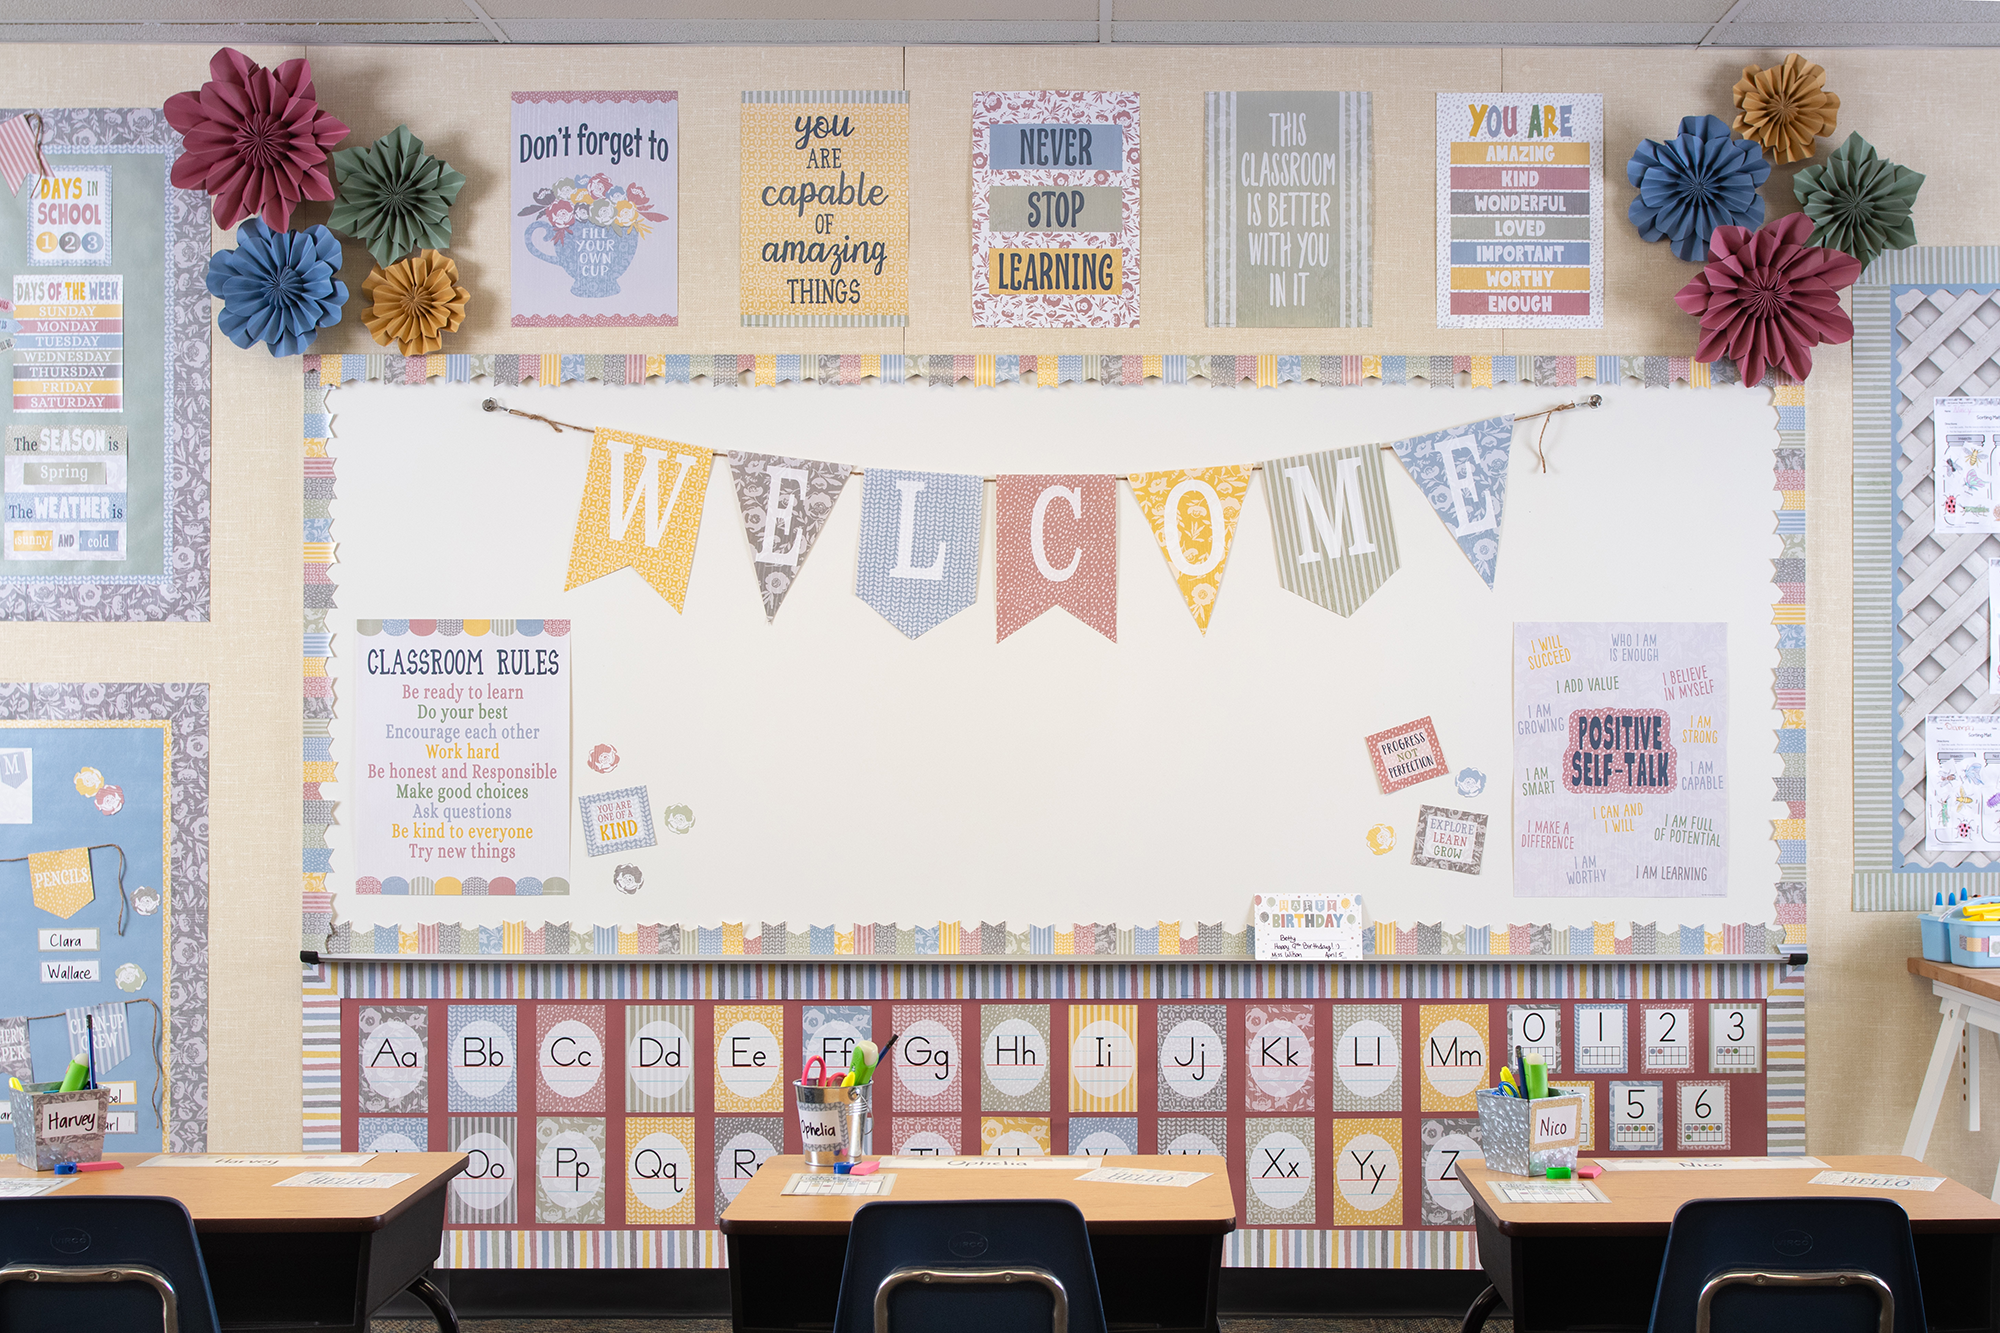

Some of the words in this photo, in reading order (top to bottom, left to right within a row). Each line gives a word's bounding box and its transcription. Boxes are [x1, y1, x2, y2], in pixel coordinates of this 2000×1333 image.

[1268, 111, 1307, 147] THIS
[1468, 103, 1518, 138] YOU
[1527, 104, 1573, 138] ARE
[795, 114, 855, 150] you
[520, 125, 571, 163] Don't
[577, 122, 643, 165] forget
[648, 129, 669, 162] to
[1019, 127, 1093, 167] NEVER
[1486, 145, 1555, 162] AMAZING
[806, 148, 842, 169] ARE
[1241, 151, 1336, 187] CLASSROOM
[41, 177, 82, 200] DAYS
[87, 181, 98, 196] IN
[1501, 170, 1539, 187] KIND
[761, 170, 889, 218] capable
[1474, 195, 1566, 212] WONDERFUL
[37, 202, 101, 225] SCHOOL
[1027, 190, 1085, 228] STOP
[1247, 192, 1262, 227] IS
[1267, 191, 1331, 228] BETTER
[582, 227, 608, 240] FILL
[815, 213, 834, 235] OF
[1495, 220, 1545, 237] LOVED
[575, 239, 615, 252] YOUR
[761, 234, 888, 276] amazing
[1248, 231, 1292, 268] WITH
[1297, 231, 1329, 269] YOU
[1476, 245, 1565, 262] IMPORTANT
[579, 252, 612, 264] OWN
[581, 265, 609, 277] CUP
[998, 252, 1113, 291] LEARNING
[1486, 270, 1554, 287] WORTHY
[16, 282, 45, 301] DAYS
[48, 282, 62, 301] OF
[64, 282, 86, 301] THE
[89, 281, 118, 300] WEEK
[786, 278, 861, 305] THINGS
[1269, 271, 1286, 307] IN
[1293, 272, 1310, 307] IT
[38, 305, 97, 317] SUNDAY
[1488, 295, 1552, 313] ENOUGH
[36, 321, 99, 332] MONDAY
[35, 336, 101, 347] TUESDAY
[23, 351, 113, 362] WEDNESDAY
[29, 366, 107, 378] THURSDAY
[42, 381, 94, 393] FRIDAY
[30, 396, 106, 408] SATURDAY
[14, 436, 38, 452] The
[40, 428, 106, 452] SEASON
[40, 464, 88, 482] Spring
[9, 503, 33, 519] The
[34, 496, 111, 519] WEATHER
[606, 433, 1501, 583] WELCOME
[17, 535, 49, 548] sunny
[58, 534, 75, 548] AND
[88, 534, 109, 548] cold
[367, 648, 484, 676] CLASSROOM
[497, 649, 559, 676] RULES
[1527, 648, 1571, 671] SUCCEED
[1622, 648, 1659, 662] ENOUGH
[1587, 675, 1619, 692] VALUE
[1670, 665, 1708, 685] BELIEVE
[402, 684, 419, 700] Be
[424, 683, 464, 703] ready
[468, 685, 483, 700] to
[487, 683, 524, 700] learn
[1679, 679, 1715, 699] MYSELF
[417, 704, 436, 719] Do
[441, 707, 474, 723] your
[478, 702, 508, 719] best
[386, 723, 460, 743] Encourage
[465, 722, 497, 739] each
[501, 722, 540, 740] other
[1517, 717, 1565, 735] GROWING
[1578, 714, 1662, 751] POSITIVE
[1682, 729, 1718, 744] STRONG
[425, 742, 462, 759] Work
[467, 743, 500, 760] hard
[1381, 731, 1426, 756] PROGRESS
[1396, 748, 1419, 763] NOT
[368, 763, 385, 779] Be
[389, 762, 436, 779] honest
[442, 763, 467, 779] and
[472, 763, 557, 783] Responsible
[1388, 754, 1435, 779] PERFECTION
[1571, 750, 1669, 787] SELF-TALK
[396, 782, 433, 799] Make
[438, 783, 471, 803] good
[476, 783, 529, 799] choices
[1522, 780, 1555, 797] SMART
[1681, 775, 1724, 791] CAPABLE
[412, 802, 439, 819] Ask
[443, 803, 512, 822] questions
[391, 823, 409, 838] Be
[413, 822, 445, 838] kind
[468, 828, 533, 843] everyone
[599, 819, 638, 842] KIND
[1430, 818, 1475, 836] EXPLORE
[1432, 832, 1468, 847] LEARN
[1521, 834, 1575, 850] DIFFERENCE
[1669, 829, 1721, 848] POTENTIAL
[409, 844, 431, 862] Try
[438, 846, 467, 859] new
[471, 842, 516, 862] things
[1433, 845, 1462, 859] GROW
[34, 867, 89, 889] PENCILS
[1566, 868, 1607, 885] WORTHY
[1661, 866, 1708, 881] LEARNING
[1280, 900, 1336, 909] HAPPY
[1272, 913, 1344, 928] BIRTHDAY
[50, 934, 82, 948] Clara
[47, 964, 92, 980] Wallace
[70, 1014, 124, 1034] CLAN-UP
[80, 1032, 118, 1051] CREW
[463, 1036, 505, 1067] Bb
[550, 1036, 592, 1067] Cc
[639, 1036, 681, 1067] Dd
[731, 1036, 767, 1067] Ee
[822, 1037, 855, 1067] Ff
[996, 1035, 1036, 1065] Hh
[1095, 1036, 1112, 1067] Ii
[1261, 1037, 1298, 1067] Kk
[1430, 1037, 1482, 1067] Mm
[371, 1037, 418, 1068] Aa
[904, 1036, 950, 1080] Gg
[1174, 1036, 1205, 1081] Jj
[1626, 1090, 1646, 1119] 5
[1695, 1089, 1711, 1118] 6
[48, 1112, 96, 1131] Harvey
[800, 1119, 836, 1140] Ophelia
[1539, 1116, 1567, 1137] Nico
[215, 1157, 279, 1166] Harvey
[463, 1149, 505, 1179] Oo
[556, 1147, 591, 1192] Pp
[634, 1148, 684, 1193] Qq
[947, 1158, 1028, 1168] Ophelia
[1262, 1148, 1300, 1179] Xx
[307, 1175, 376, 1186] HELLO
[1108, 1170, 1175, 1184] HELLO
[1351, 1150, 1386, 1195] Yy
[1840, 1175, 1913, 1188] HELLO
